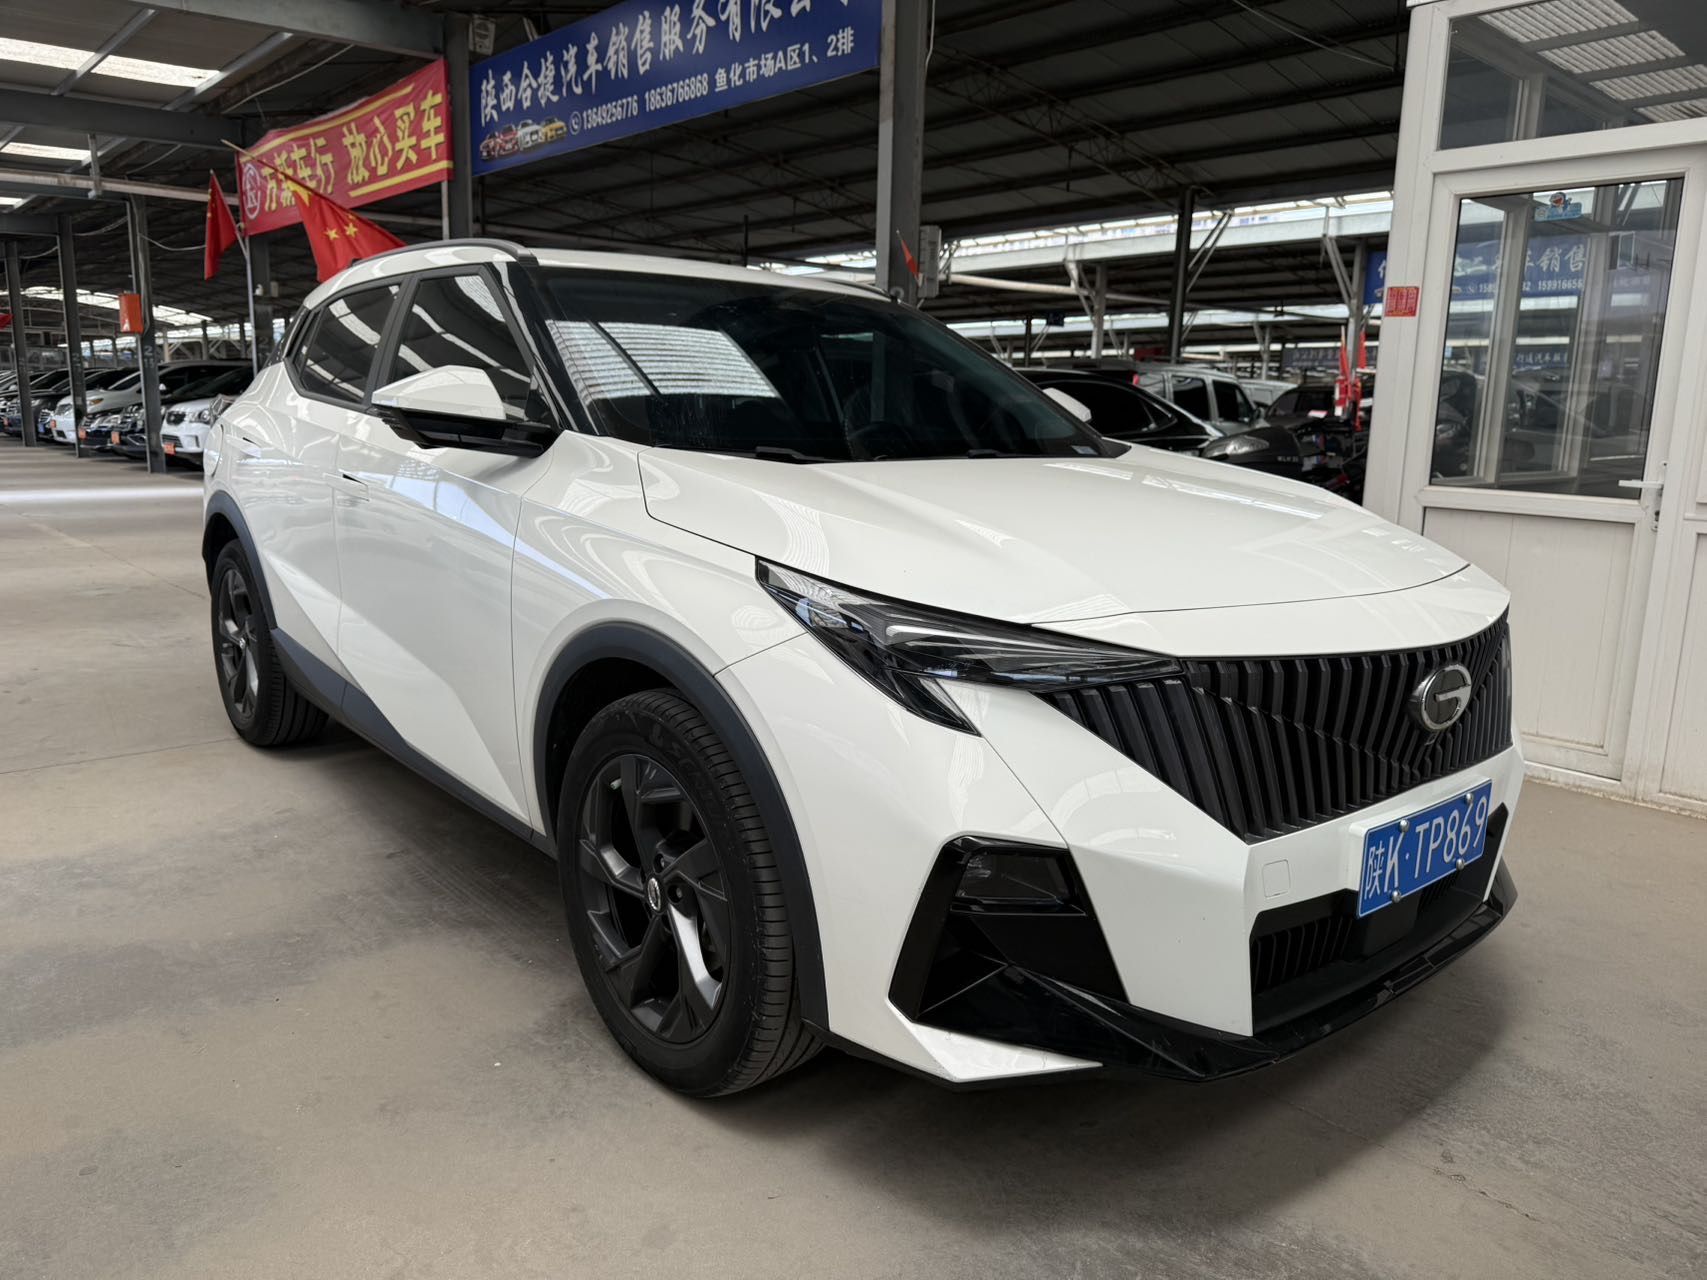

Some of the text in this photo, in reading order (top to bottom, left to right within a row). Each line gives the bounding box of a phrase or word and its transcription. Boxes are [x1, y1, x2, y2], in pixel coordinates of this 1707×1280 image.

[480, 0, 850, 127] 陕西合捷汽车销售服务有限
[582, 95, 639, 130] 13649256776
[645, 73, 709, 111] 18636766868
[342, 89, 445, 185] 放心买车
[1363, 796, 1488, 900] 陕K·TP869
